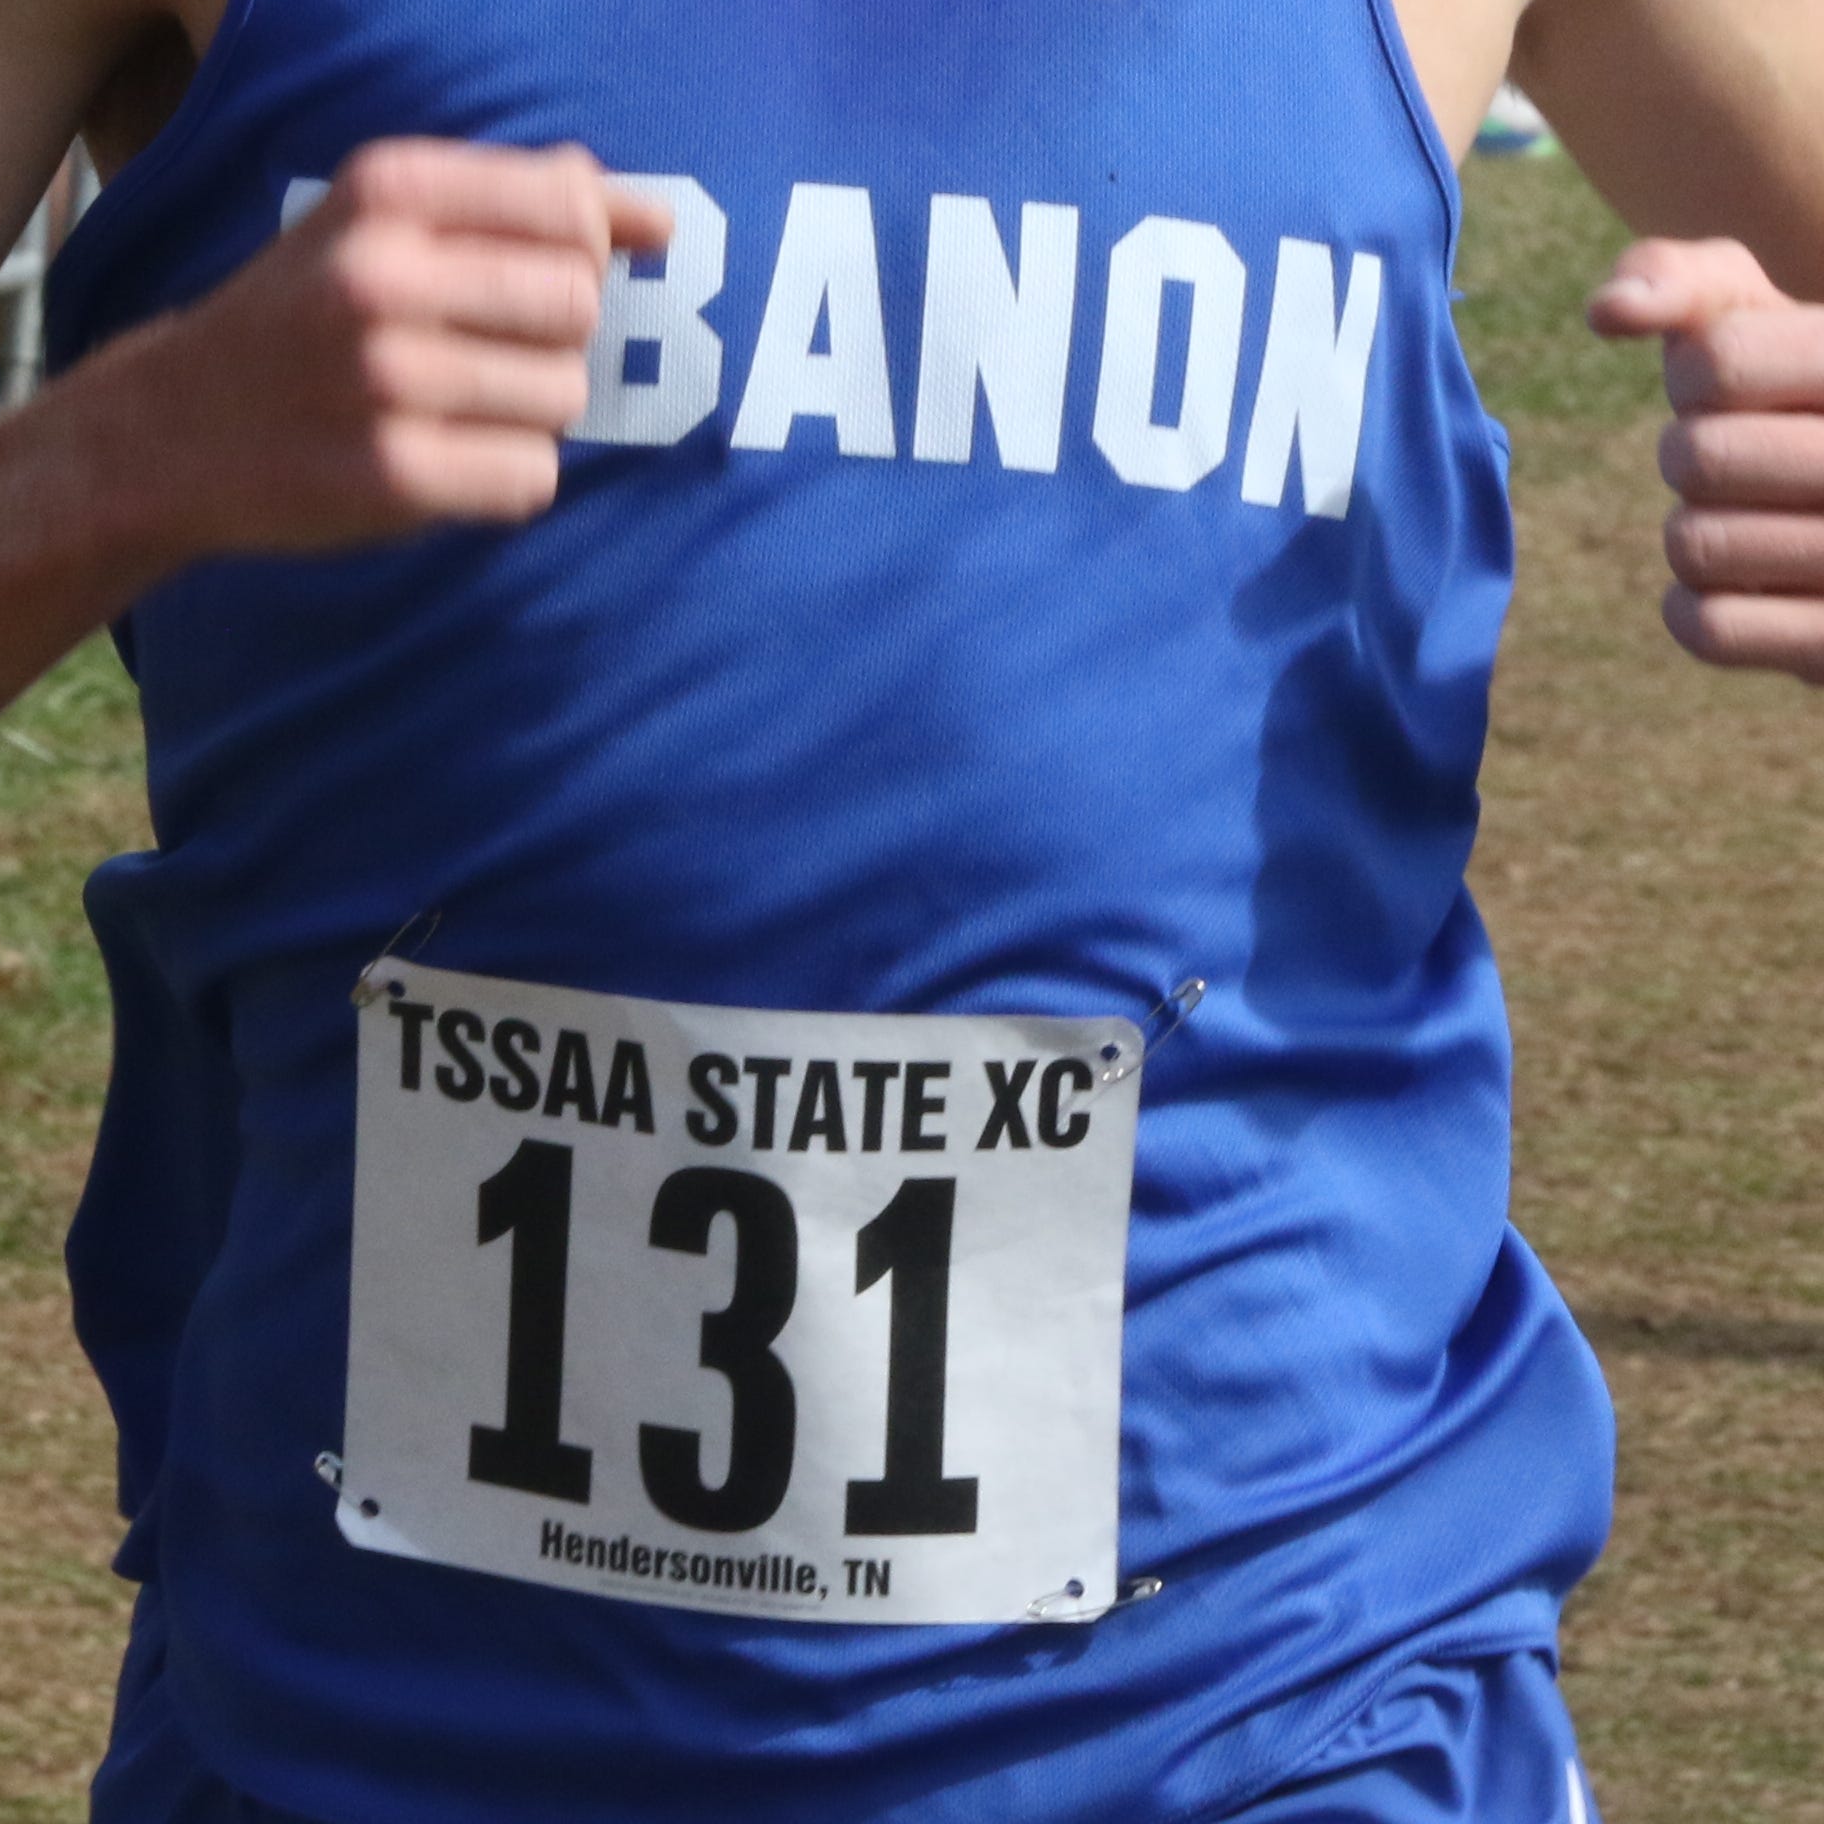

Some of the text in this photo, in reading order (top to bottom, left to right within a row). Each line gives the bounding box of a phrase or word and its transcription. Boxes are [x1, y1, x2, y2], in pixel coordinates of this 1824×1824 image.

[280, 174, 1382, 519] BANON
[389, 1000, 1095, 1153] TSSAA STATE XC
[466, 1136, 980, 1537] 131
[539, 1518, 829, 1601] Hendersonville,
[843, 1558, 892, 1598] TN
